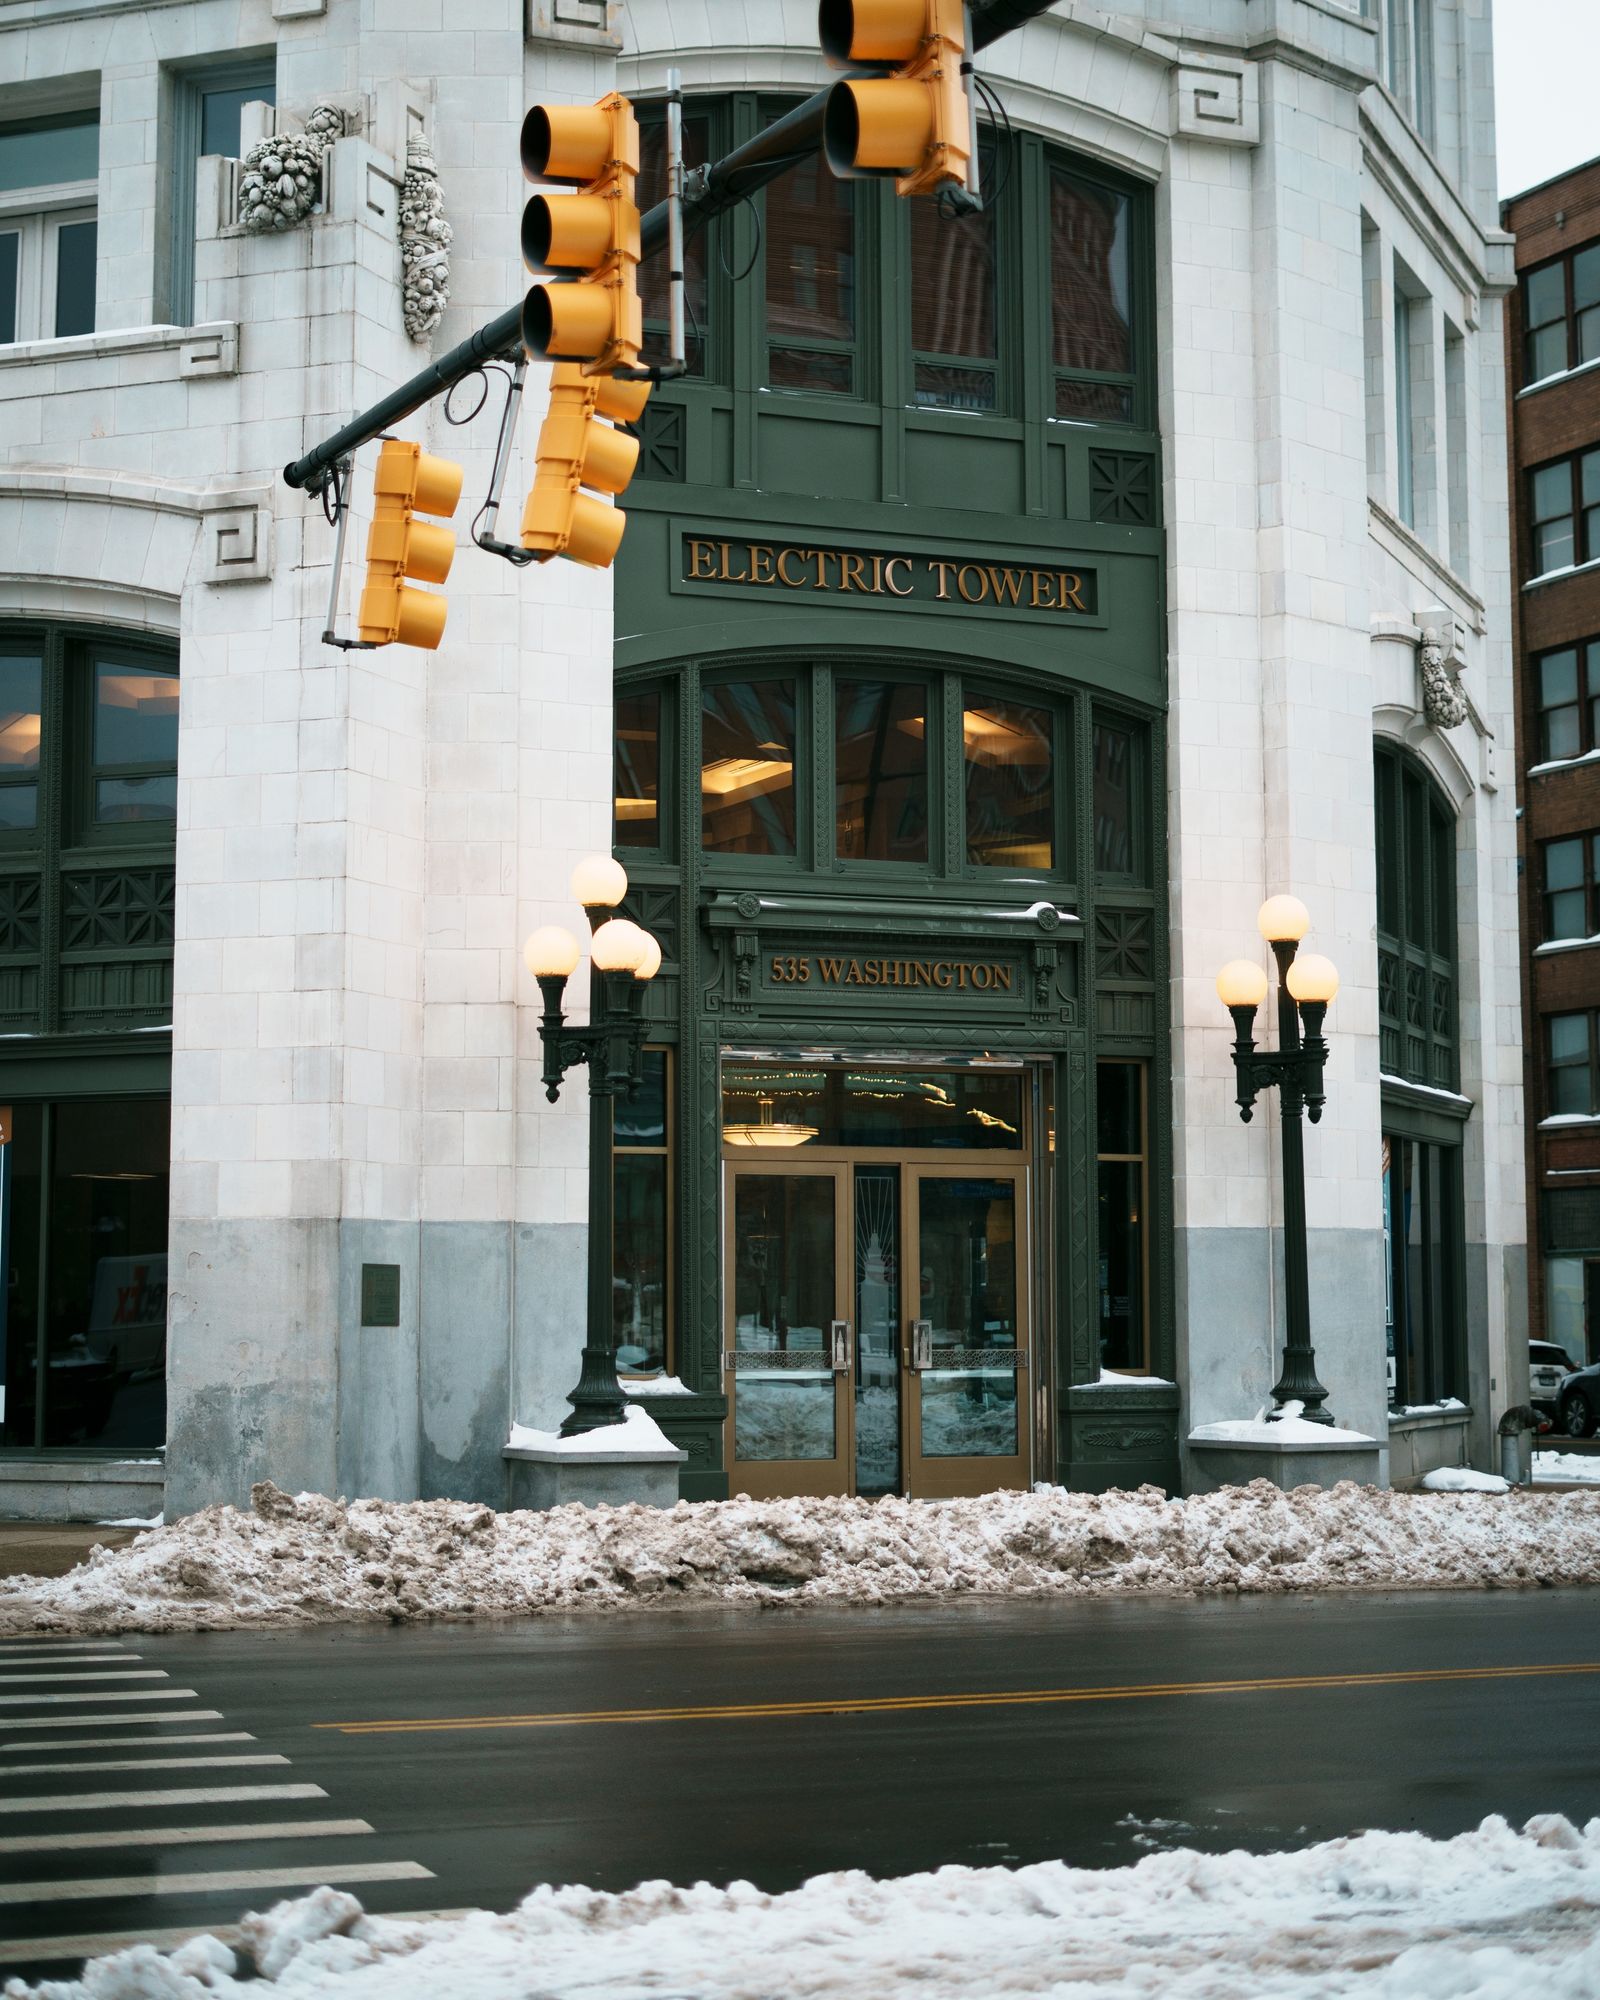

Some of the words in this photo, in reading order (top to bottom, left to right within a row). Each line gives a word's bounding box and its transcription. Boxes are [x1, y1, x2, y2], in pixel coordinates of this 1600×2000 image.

[687, 540, 915, 596] ELECTRIC
[928, 561, 1088, 611] TOWER
[771, 957, 811, 982] 535
[817, 957, 1013, 990] WASHINGTON
